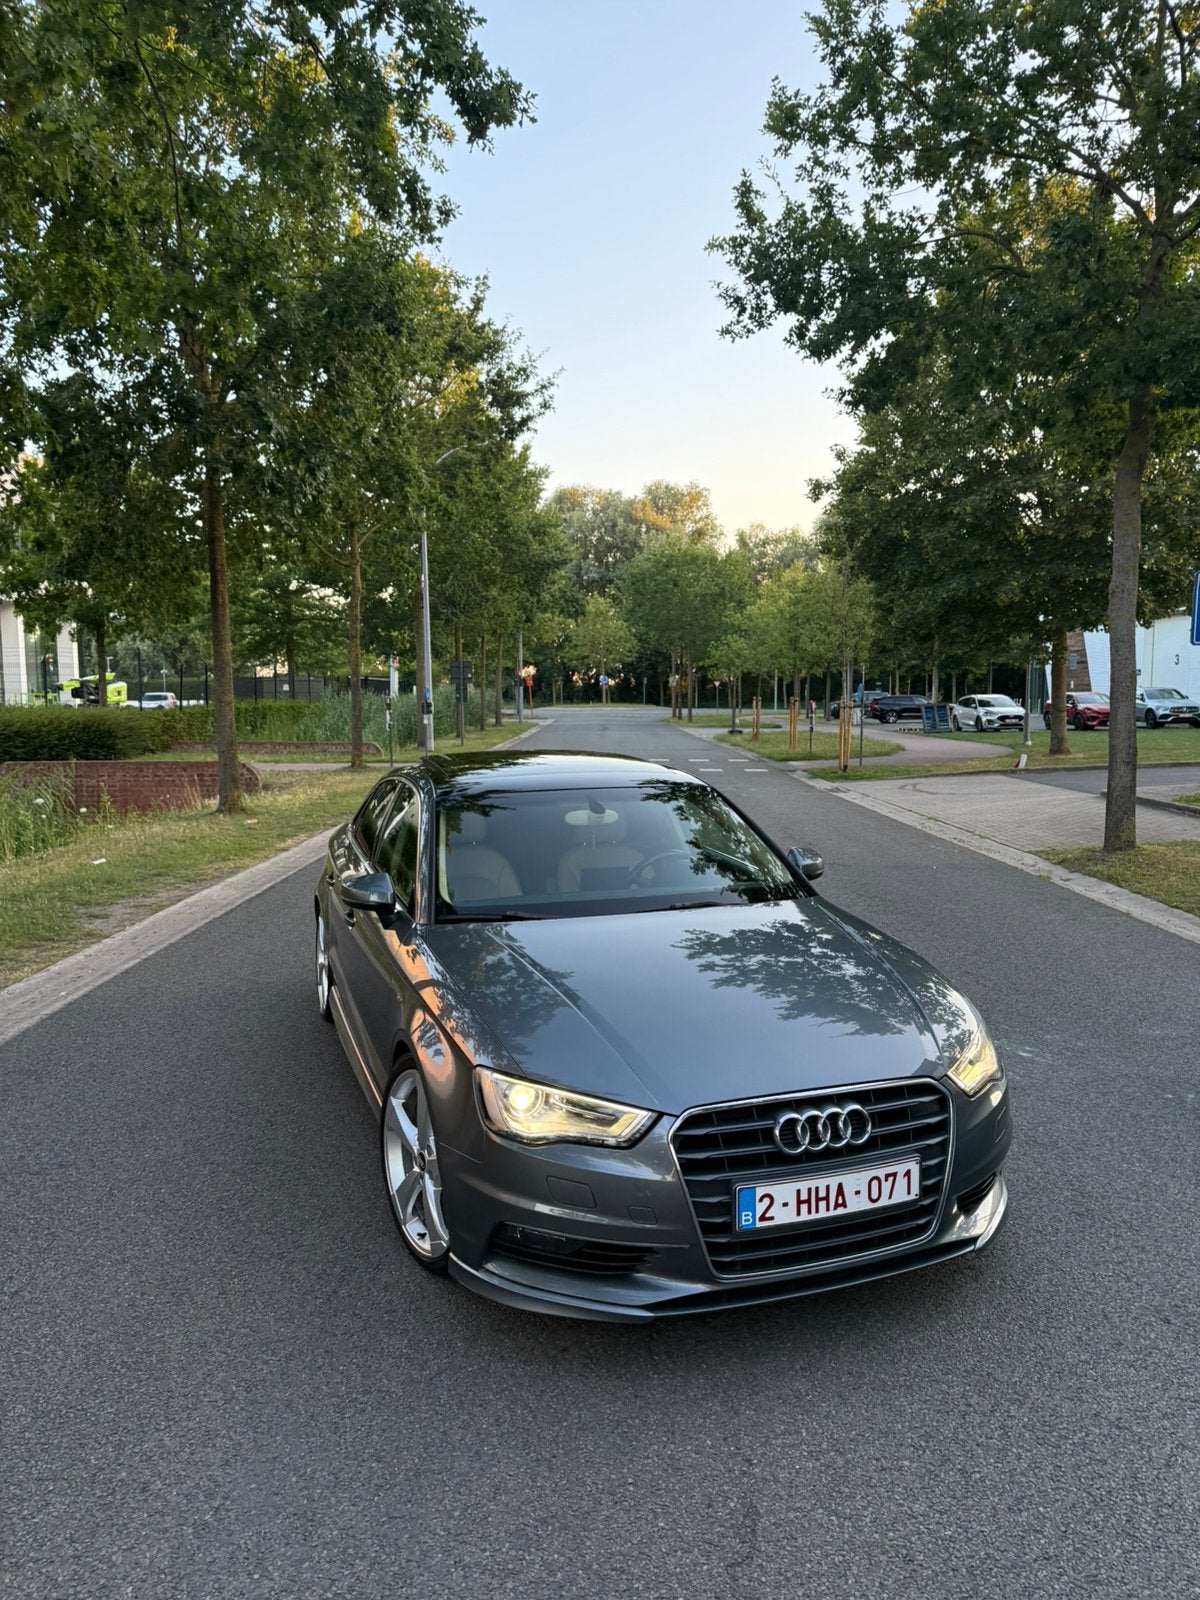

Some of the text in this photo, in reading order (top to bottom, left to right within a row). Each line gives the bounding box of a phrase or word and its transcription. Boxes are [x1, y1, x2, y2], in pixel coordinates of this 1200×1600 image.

[1174, 654, 1180, 665] 3
[741, 1168, 912, 1225] B 2-HHA-071
